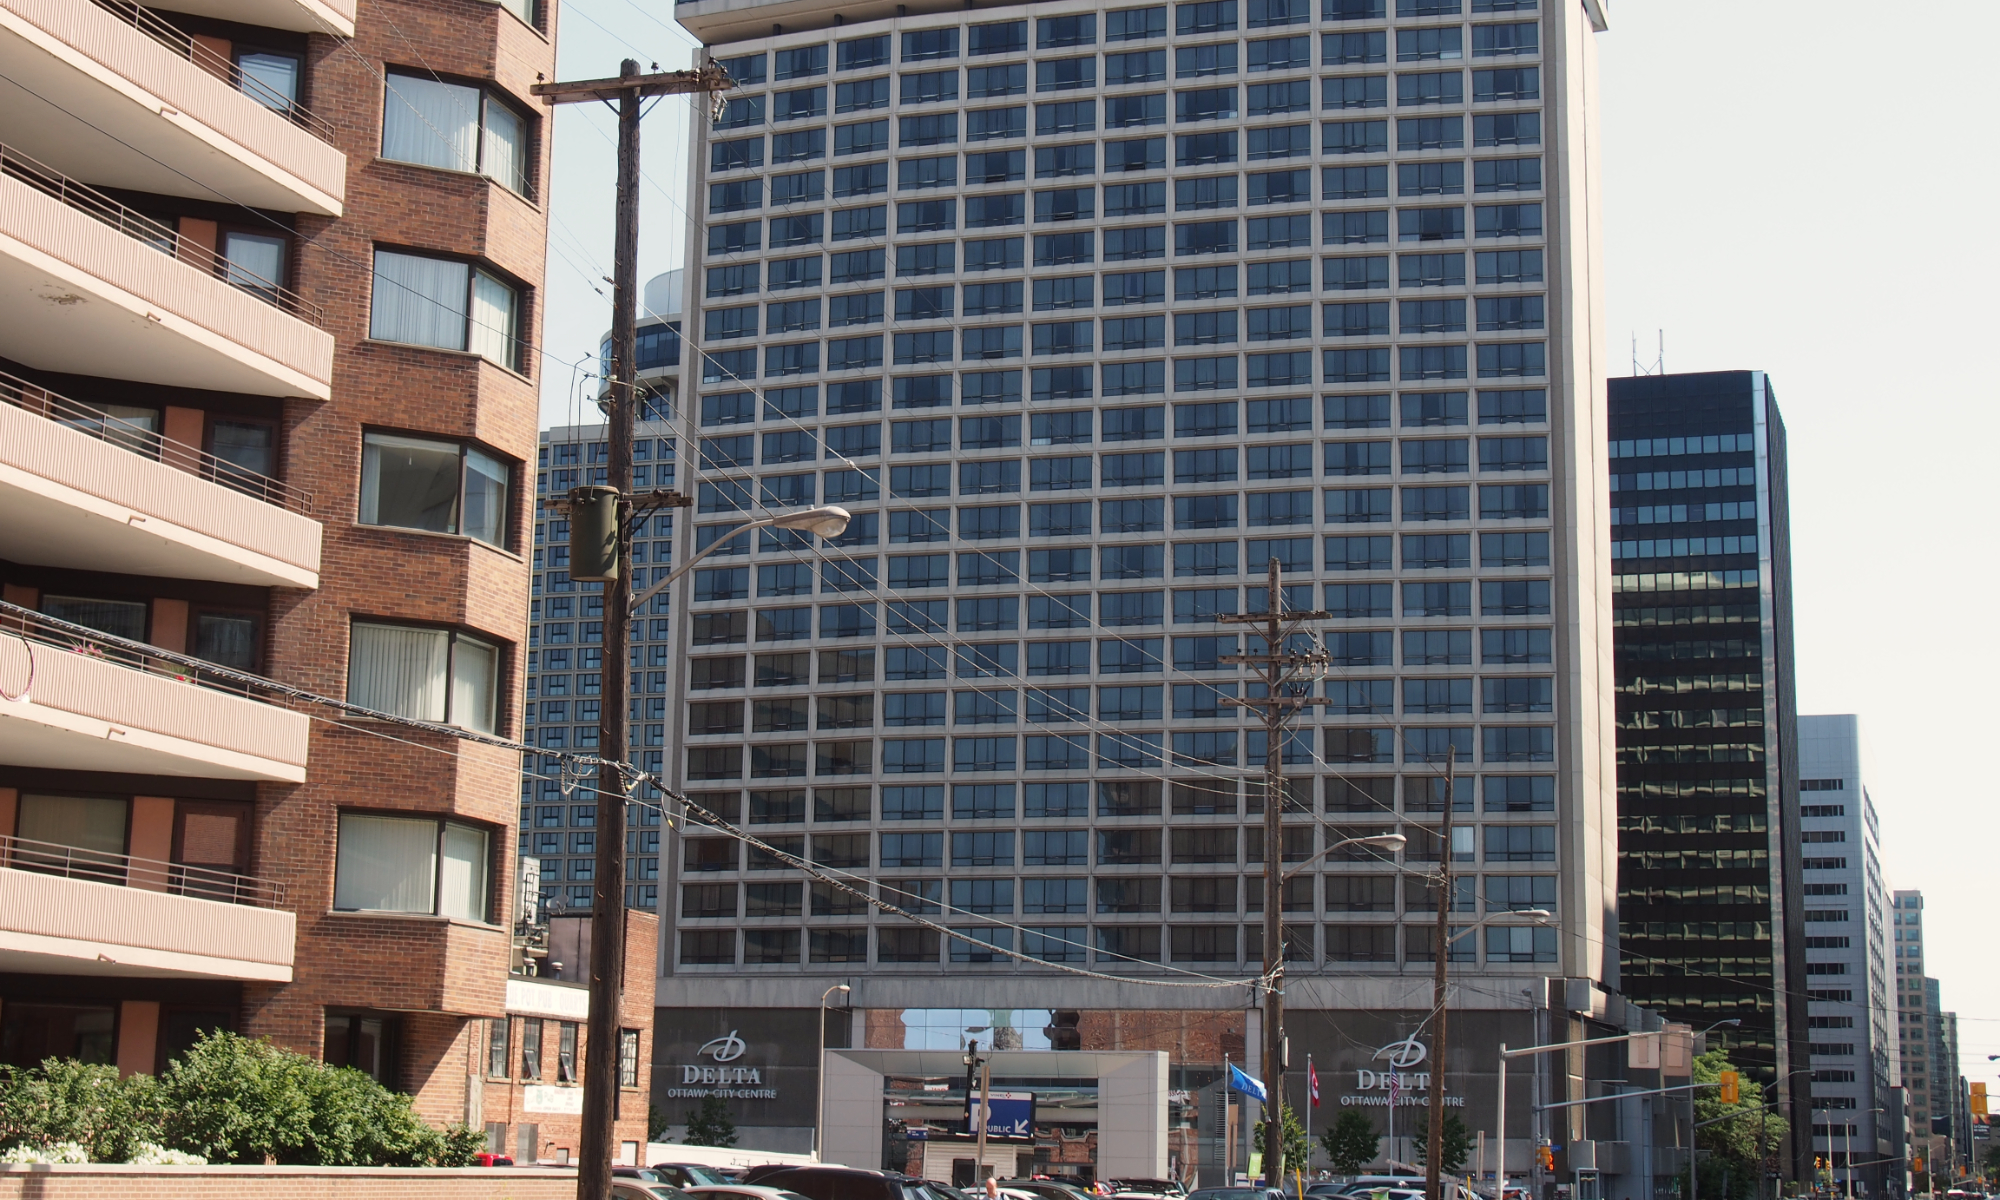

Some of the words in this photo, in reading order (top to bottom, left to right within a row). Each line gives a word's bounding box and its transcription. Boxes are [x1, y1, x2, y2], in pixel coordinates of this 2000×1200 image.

[521, 986, 536, 1006] POT
[538, 989, 553, 1009] PUB
[682, 1065, 762, 1084] DELTA
[1356, 1069, 1448, 1091] DELT
[667, 1088, 709, 1099] OTTAWA
[712, 1088, 735, 1099] CITY
[737, 1088, 777, 1099] CENTRE
[1241, 1082, 1264, 1097] DELT
[1340, 1095, 1388, 1106] OTTAWA
[1421, 1096, 1465, 1107] CTRE
[970, 1103, 992, 1132] P
[986, 1125, 1011, 1133] UBLIC
